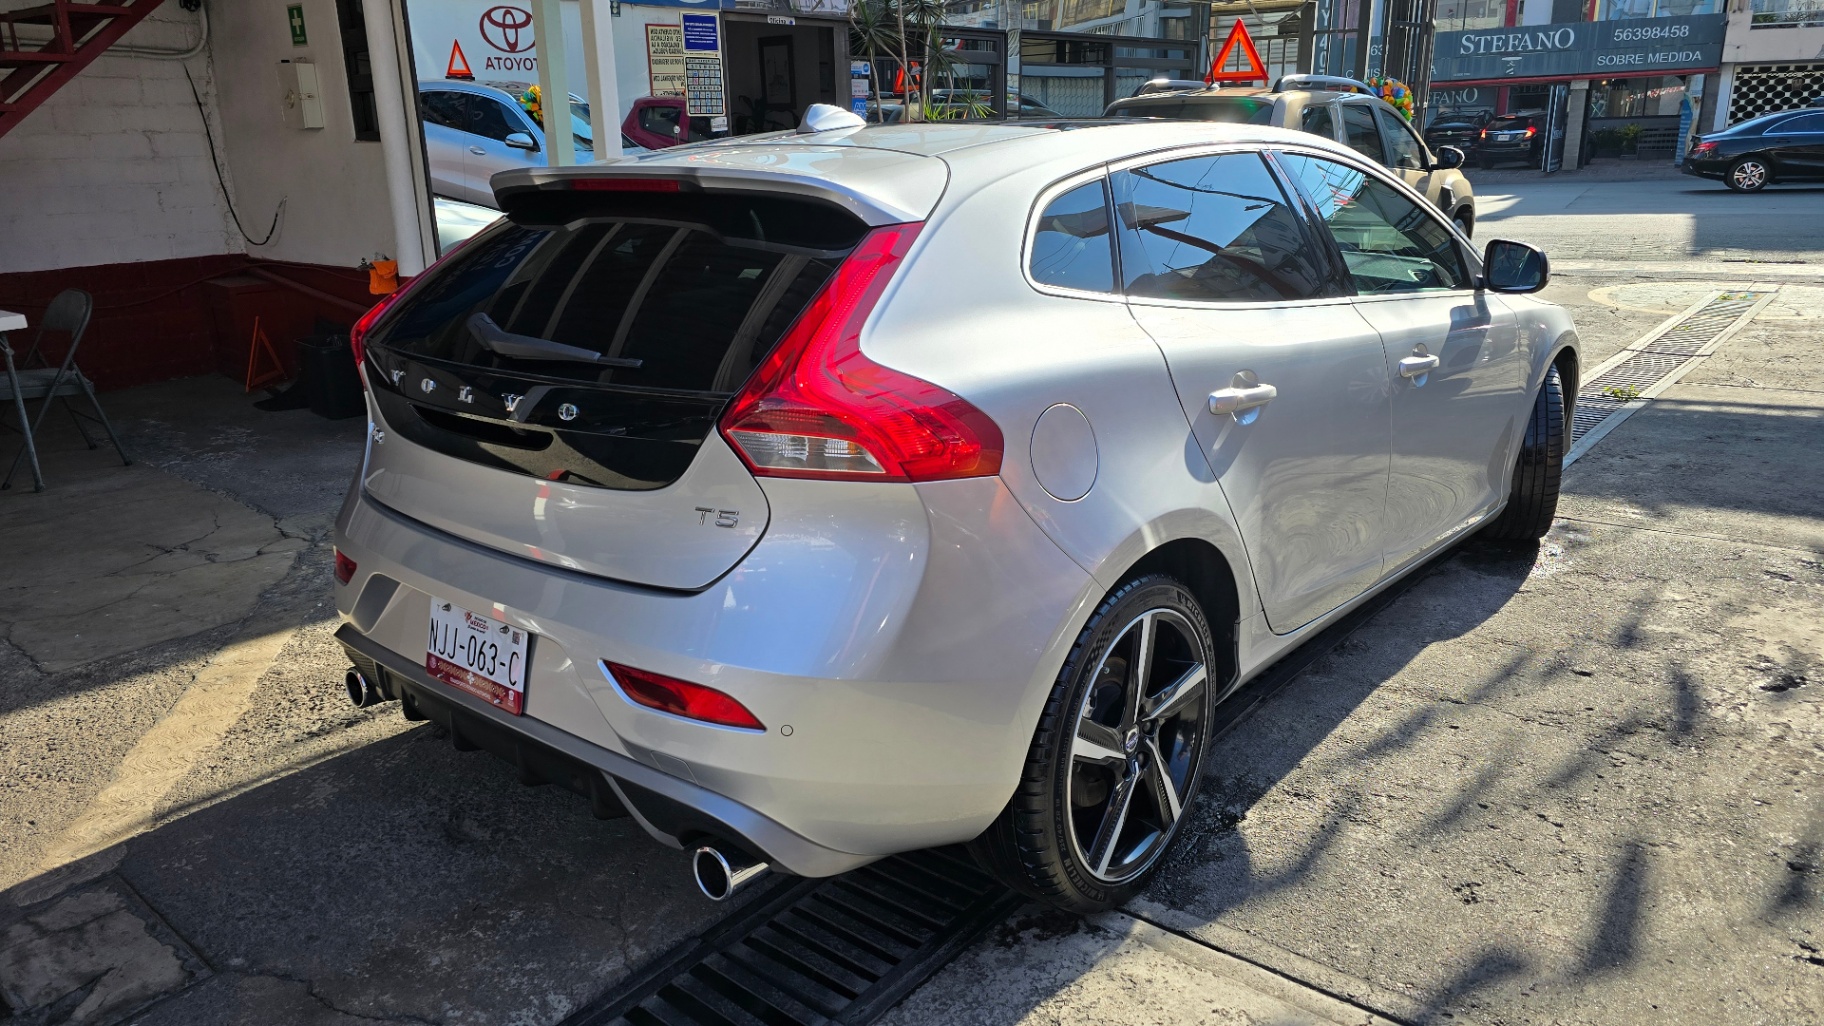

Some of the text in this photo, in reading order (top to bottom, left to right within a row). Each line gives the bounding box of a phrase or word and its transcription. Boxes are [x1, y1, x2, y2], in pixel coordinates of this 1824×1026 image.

[1460, 27, 1575, 55] STEFANO
[1613, 25, 1690, 42] 56398458
[1596, 51, 1702, 66] SOBRE MEDIDA
[391, 369, 581, 421] VOLVO
[695, 506, 740, 529] T5
[429, 617, 520, 687] NJJ-063-C
[1063, 857, 1099, 899] MICHELIN
